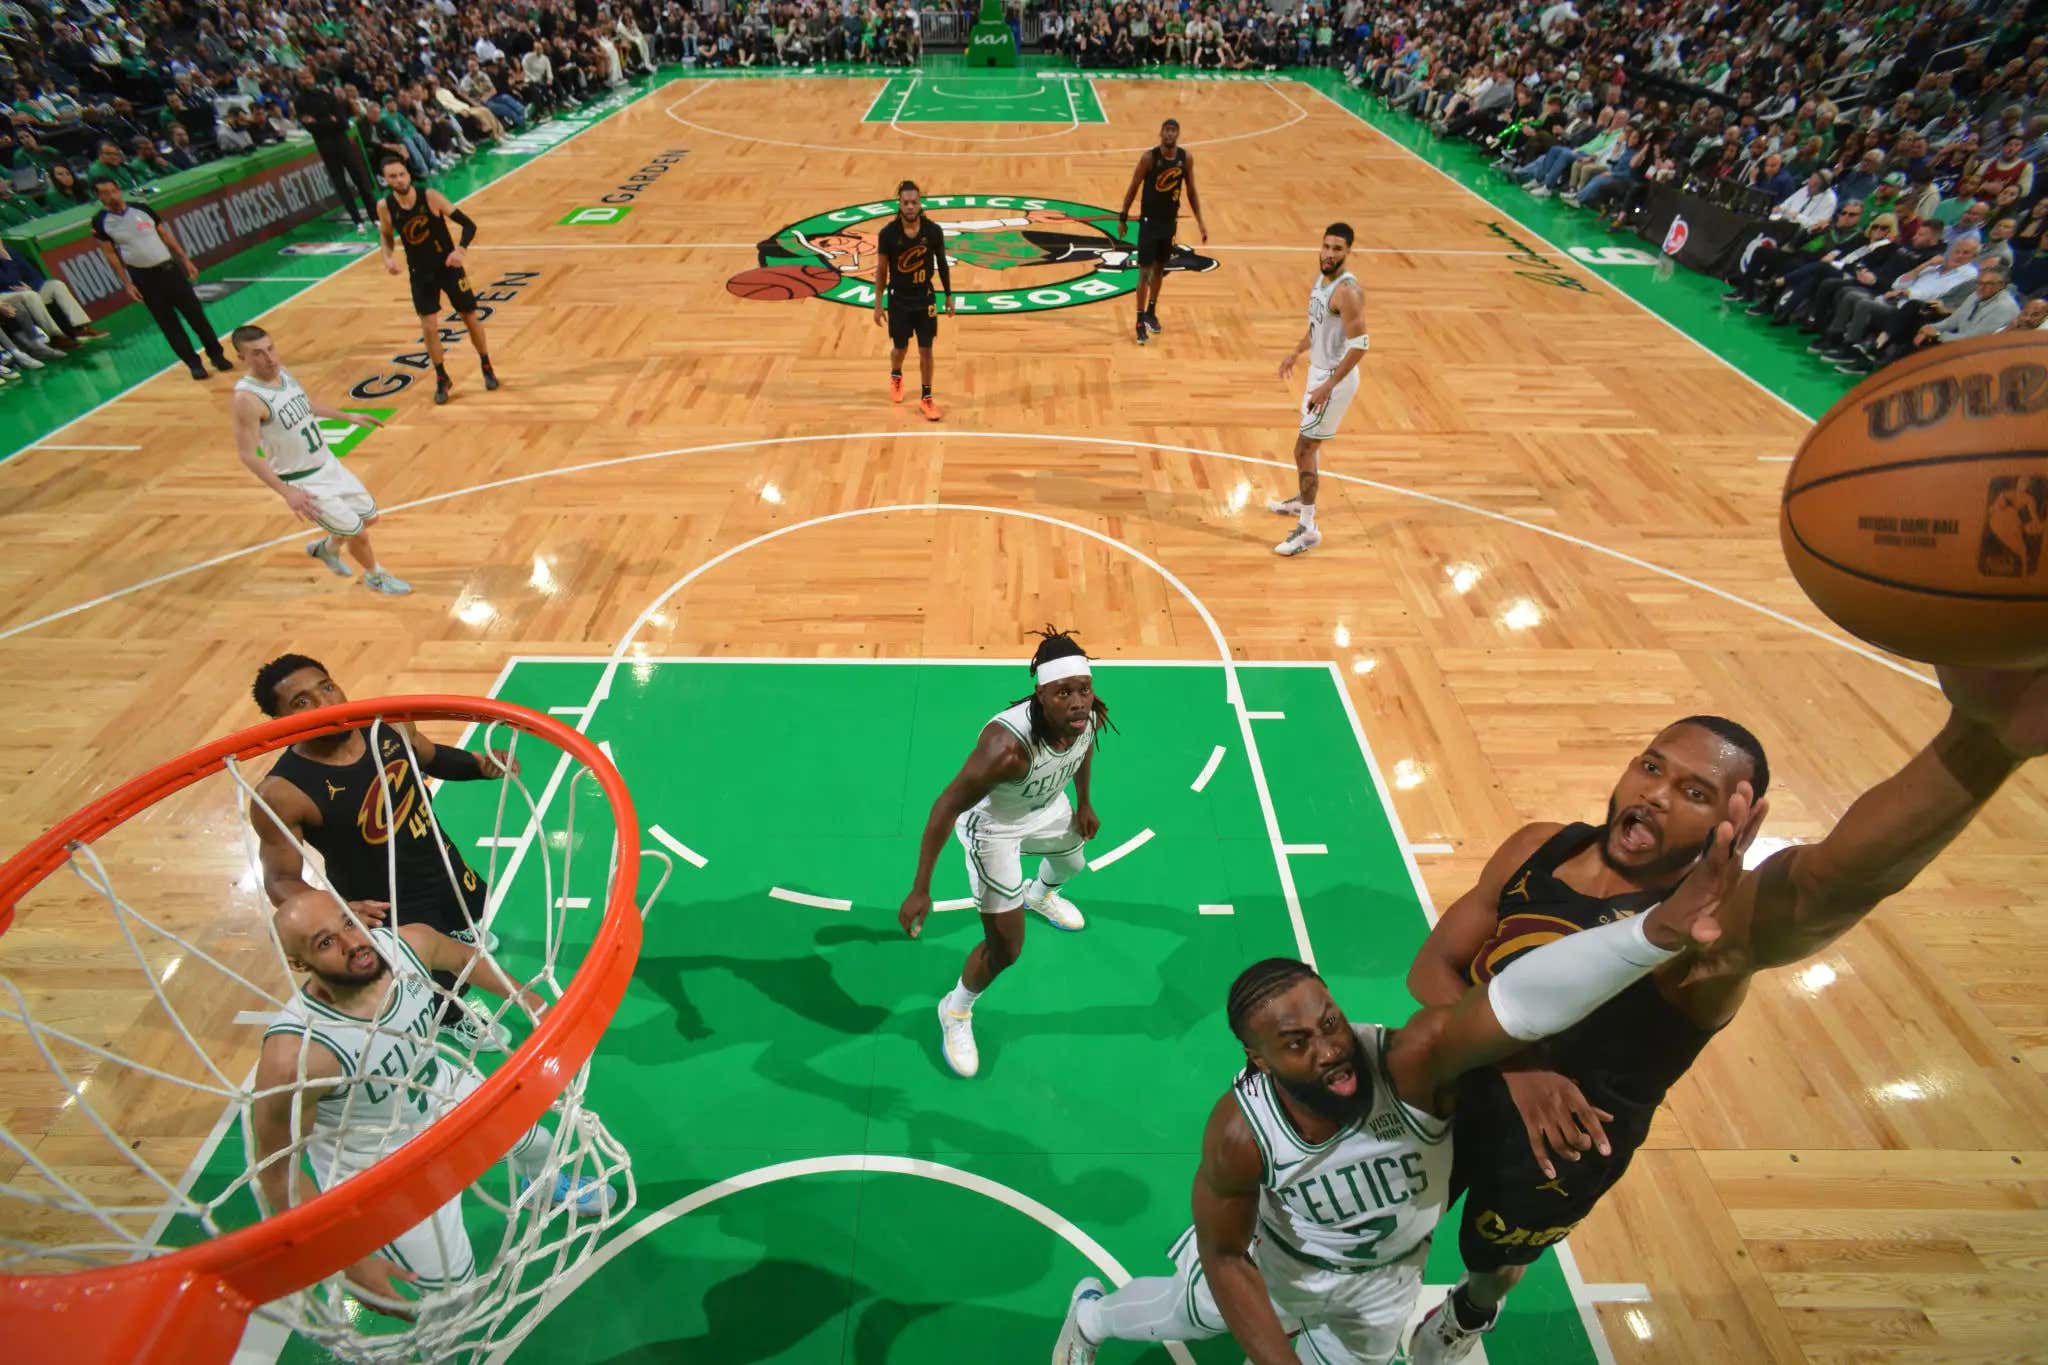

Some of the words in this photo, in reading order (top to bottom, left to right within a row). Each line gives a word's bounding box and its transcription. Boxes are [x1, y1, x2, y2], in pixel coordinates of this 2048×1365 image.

[279, 171, 312, 213] GET
[601, 149, 691, 203] GARDEN
[828, 196, 1048, 222] CETICS
[913, 269, 926, 284] 10
[838, 279, 1120, 311] BOSTN
[301, 421, 323, 454] 11
